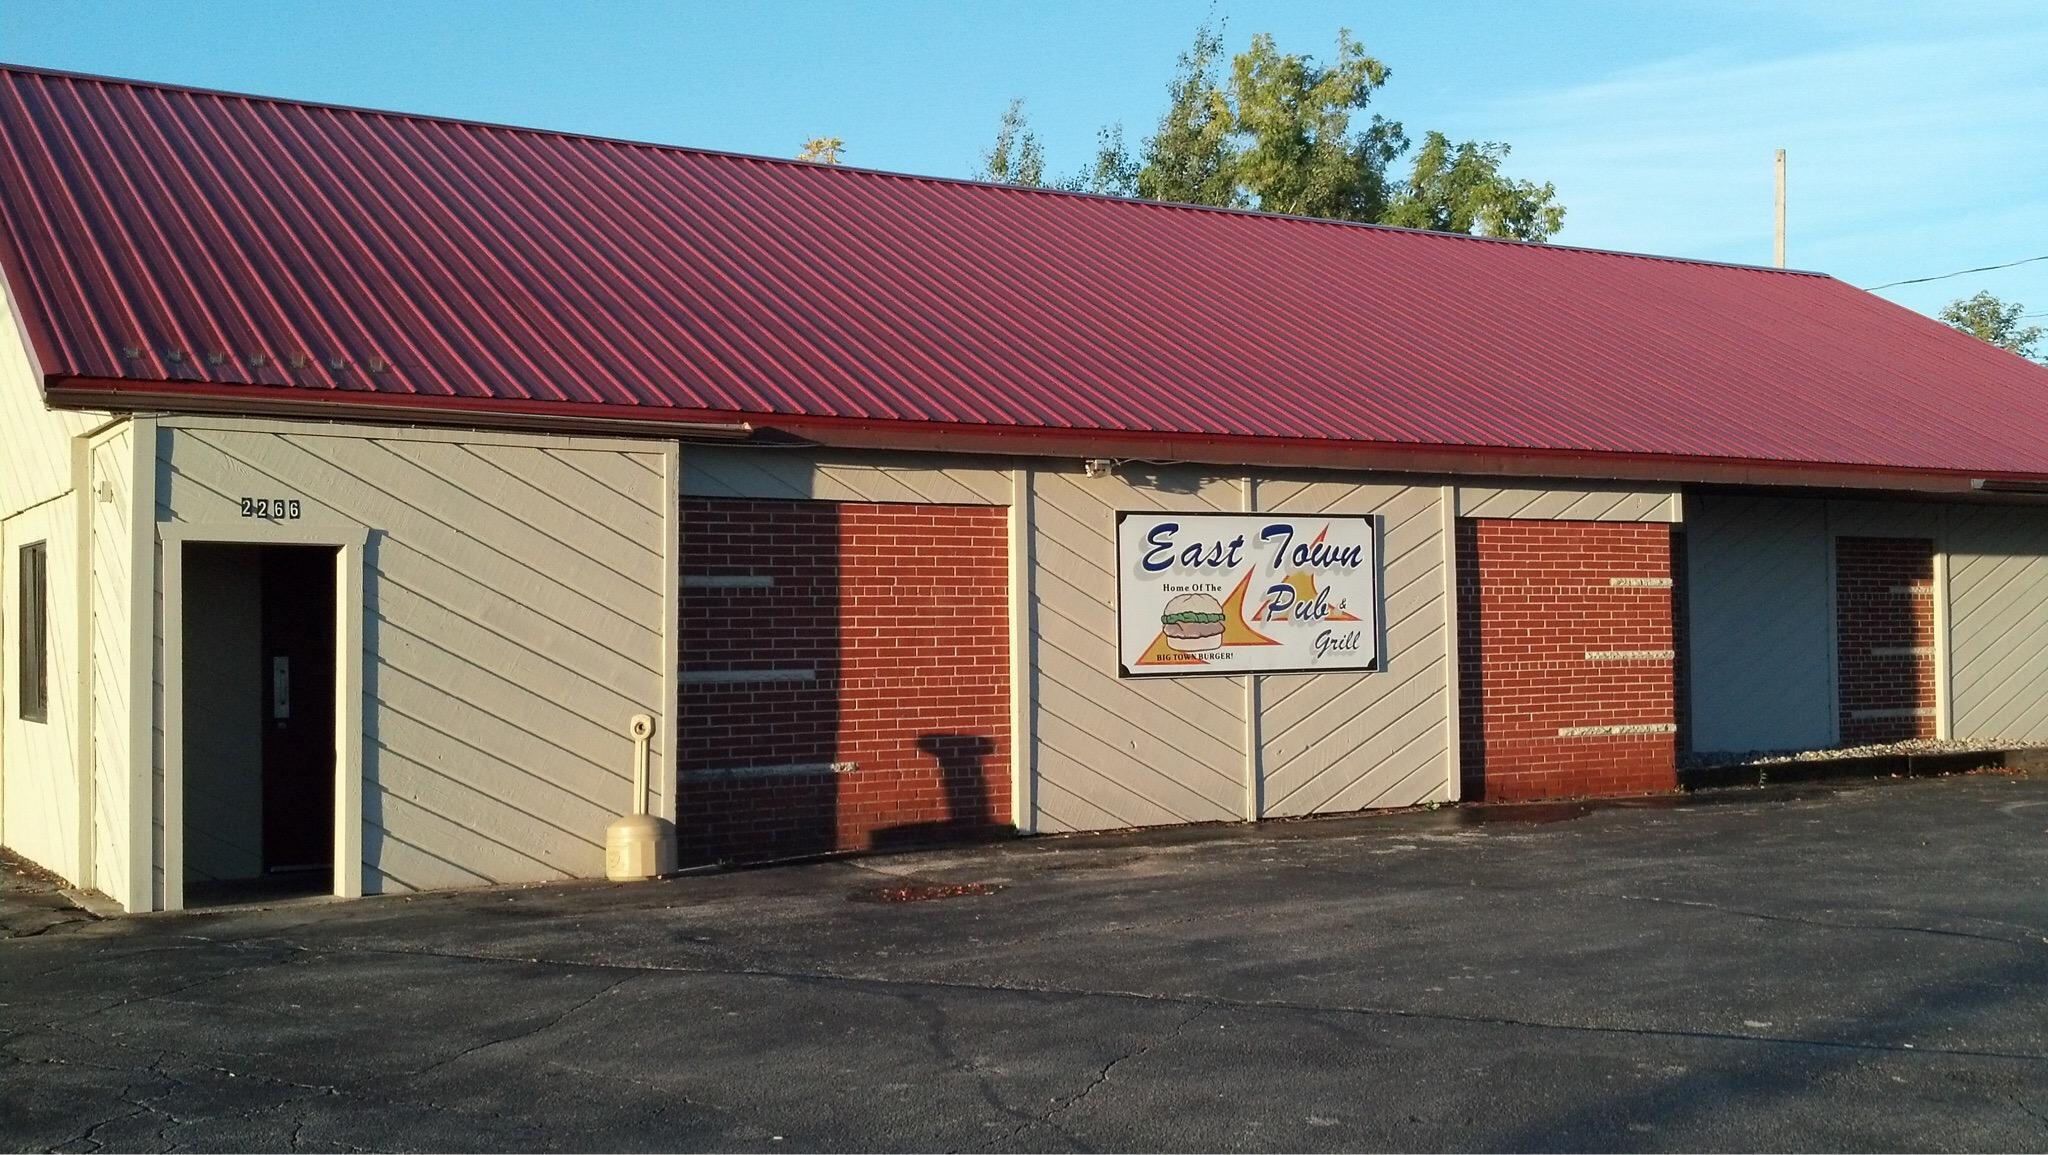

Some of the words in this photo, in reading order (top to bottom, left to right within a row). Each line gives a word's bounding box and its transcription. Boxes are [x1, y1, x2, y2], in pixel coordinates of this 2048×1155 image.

[242, 498, 300, 518] 2266
[1142, 523, 1244, 571] East
[1261, 524, 1363, 569] Town
[1163, 583, 1190, 592] Home
[1192, 583, 1203, 592] Of
[1205, 583, 1222, 592] The
[1266, 584, 1330, 622] Pub
[1339, 598, 1347, 610] &
[1315, 629, 1361, 658] Grill
[1156, 653, 1171, 661] BIG
[1173, 653, 1198, 661] TOWN
[1198, 652, 1234, 661] BURGER!
